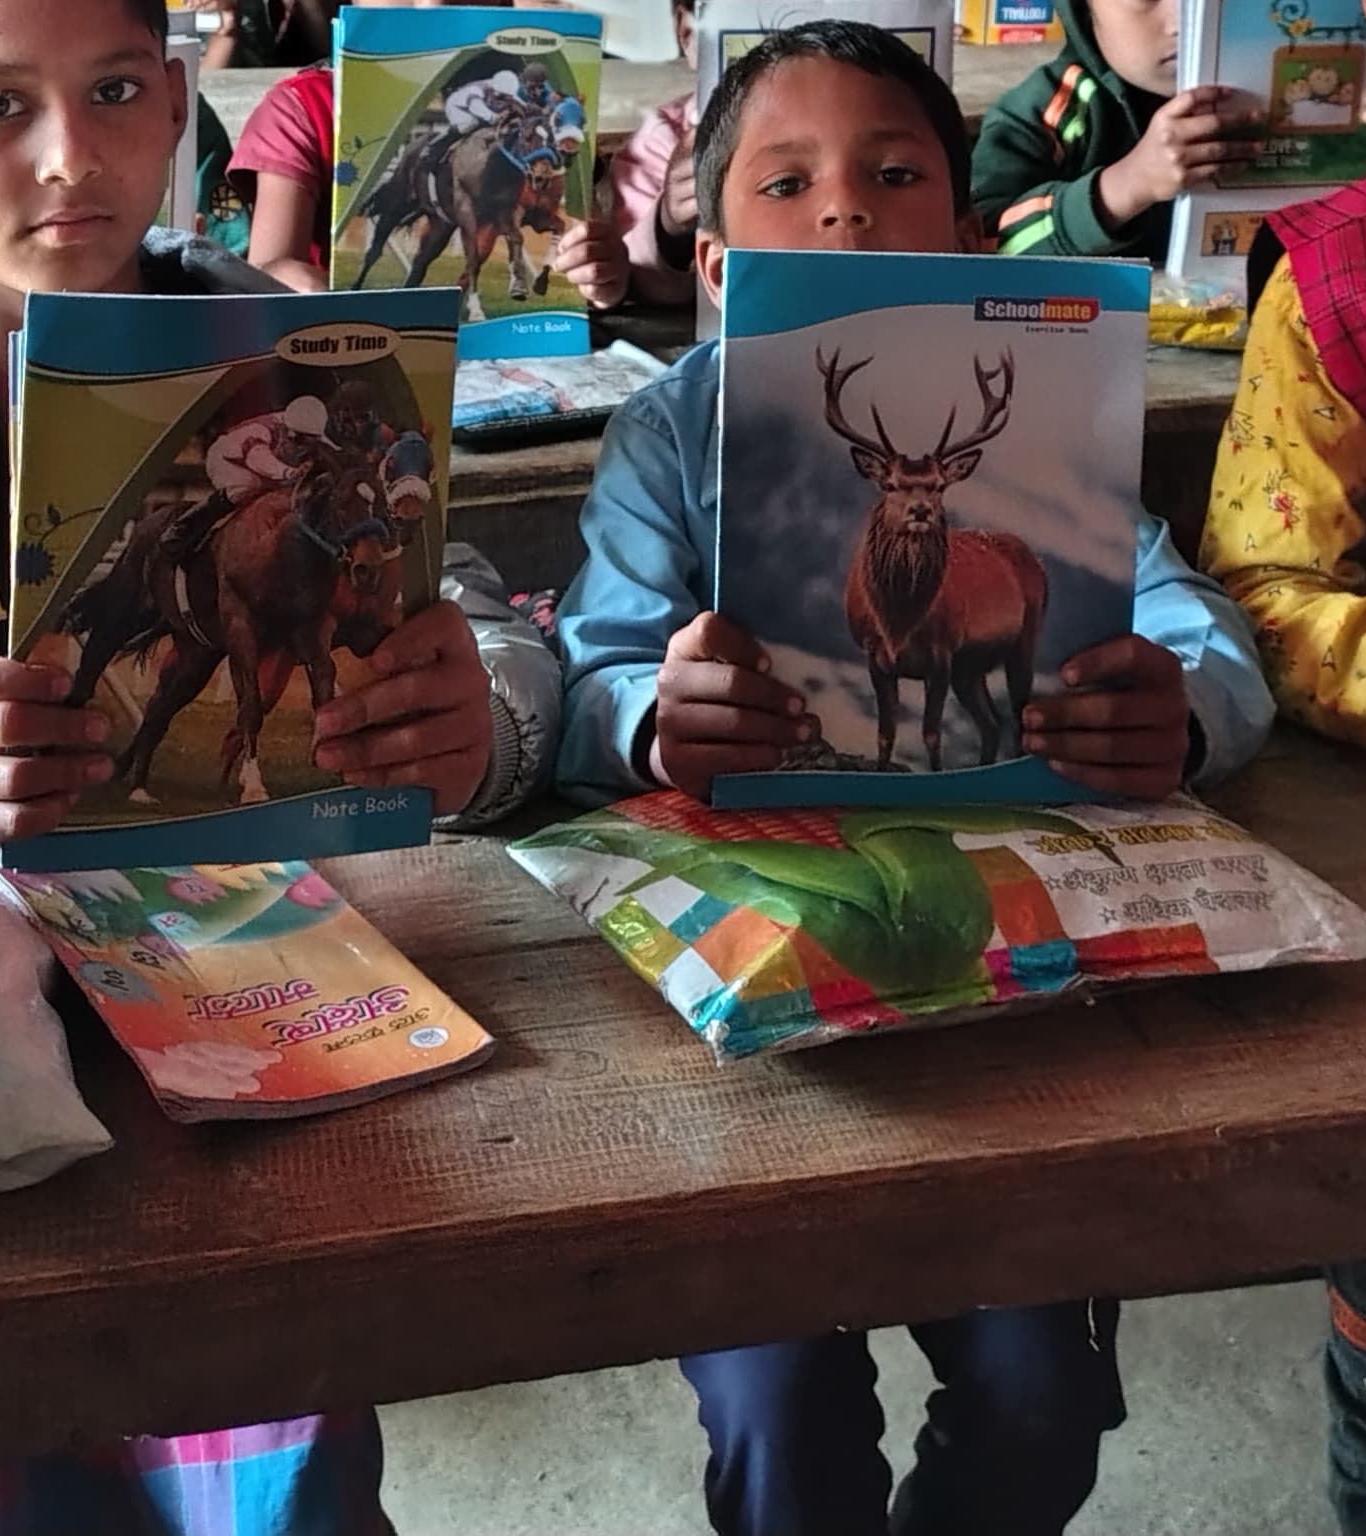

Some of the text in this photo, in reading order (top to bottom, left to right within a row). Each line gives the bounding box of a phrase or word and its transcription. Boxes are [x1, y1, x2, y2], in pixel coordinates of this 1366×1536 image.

[496, 35, 557, 46] Study Time
[983, 300, 1092, 320] Schoolmate
[512, 319, 572, 335] Note Book
[290, 334, 388, 355] Study Time
[312, 793, 409, 819] Note Book
[184, 978, 321, 1020] माला
[261, 983, 411, 1048] अक्षर
